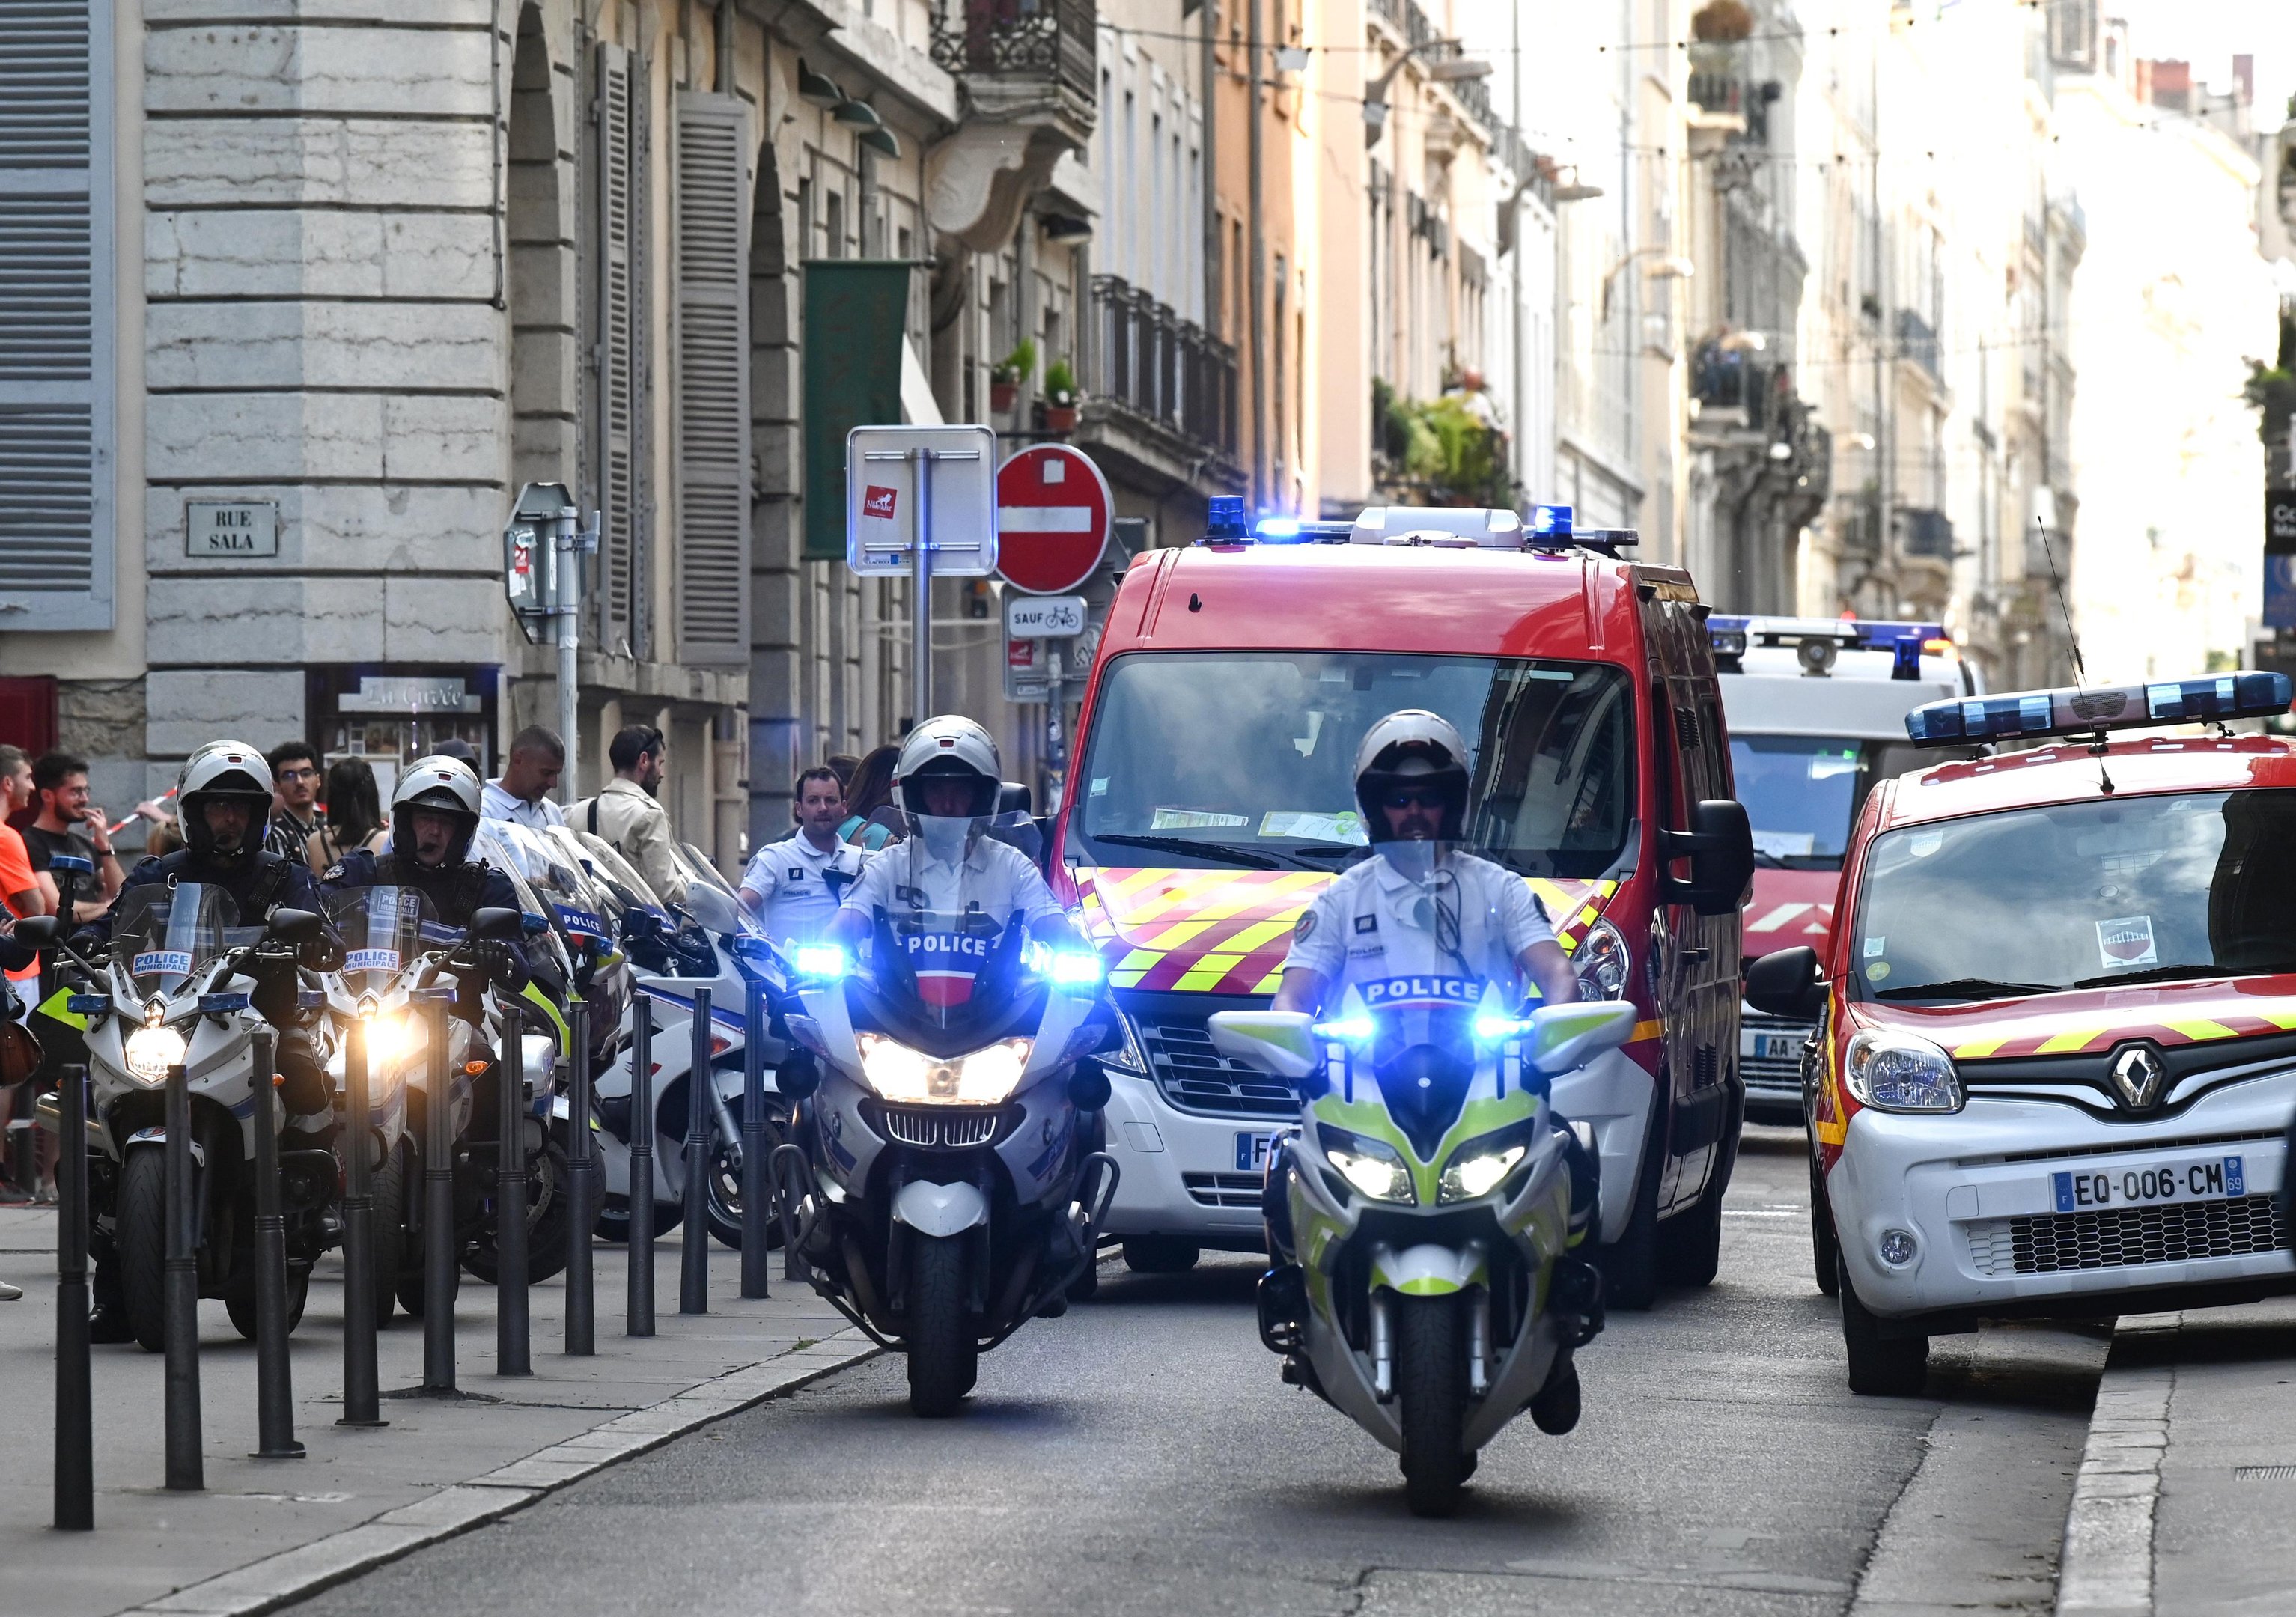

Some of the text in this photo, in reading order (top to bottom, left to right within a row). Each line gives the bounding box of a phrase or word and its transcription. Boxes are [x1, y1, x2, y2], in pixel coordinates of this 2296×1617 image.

[216, 511, 251, 526] RUE
[210, 534, 253, 549] SALA
[1014, 613, 1043, 624] SAUF
[563, 914, 602, 933] POLICE
[908, 935, 987, 957] POLICE
[135, 954, 189, 967] POLICE
[346, 951, 398, 963] POLICE
[134, 963, 189, 973] MUNICIPALE
[344, 960, 397, 970] MUNICIPALE
[1366, 978, 1480, 1002] POLICE
[1241, 1153, 1246, 1161] F
[2075, 1163, 2224, 1206] EQ-006-CM
[2226, 1177, 2242, 1191] 69
[2062, 1195, 2068, 1205] F
